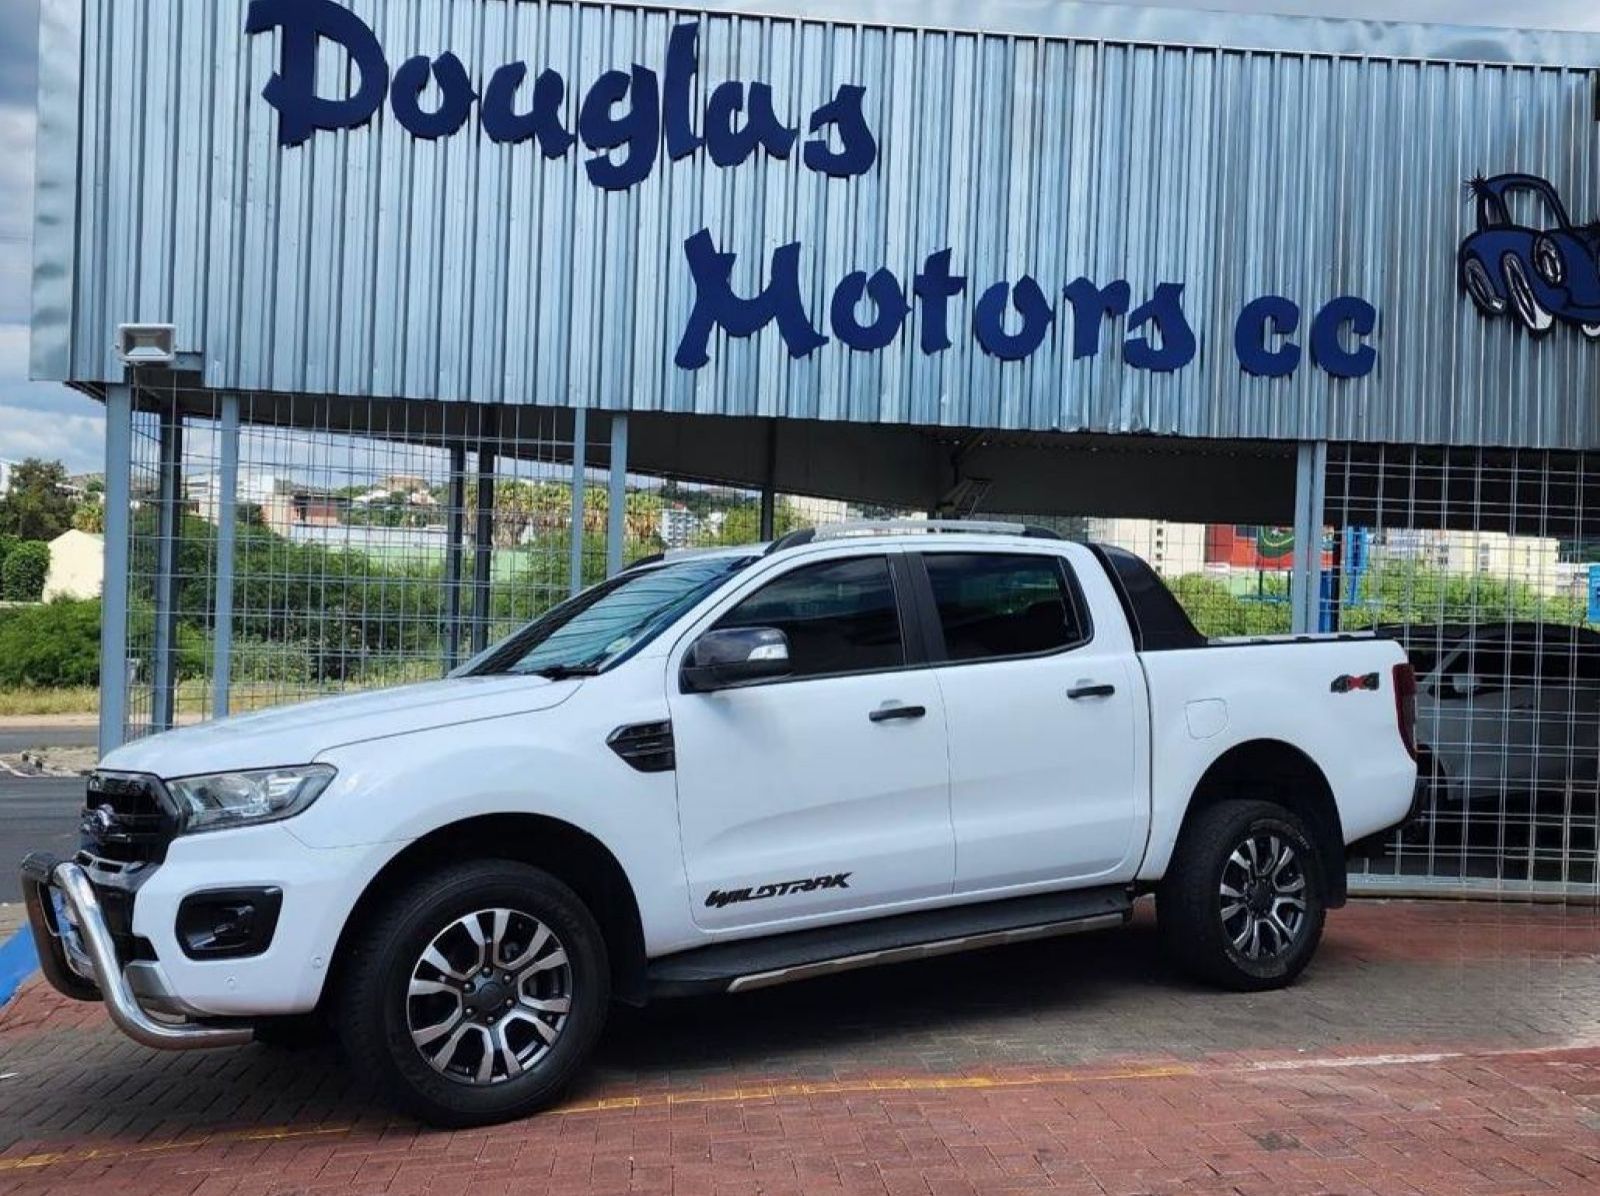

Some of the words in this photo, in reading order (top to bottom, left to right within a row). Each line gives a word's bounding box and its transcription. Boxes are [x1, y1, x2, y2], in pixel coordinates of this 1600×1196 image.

[246, 0, 877, 190] Douglas
[676, 229, 1197, 370] Motors
[704, 871, 853, 908] WILDTRAK
